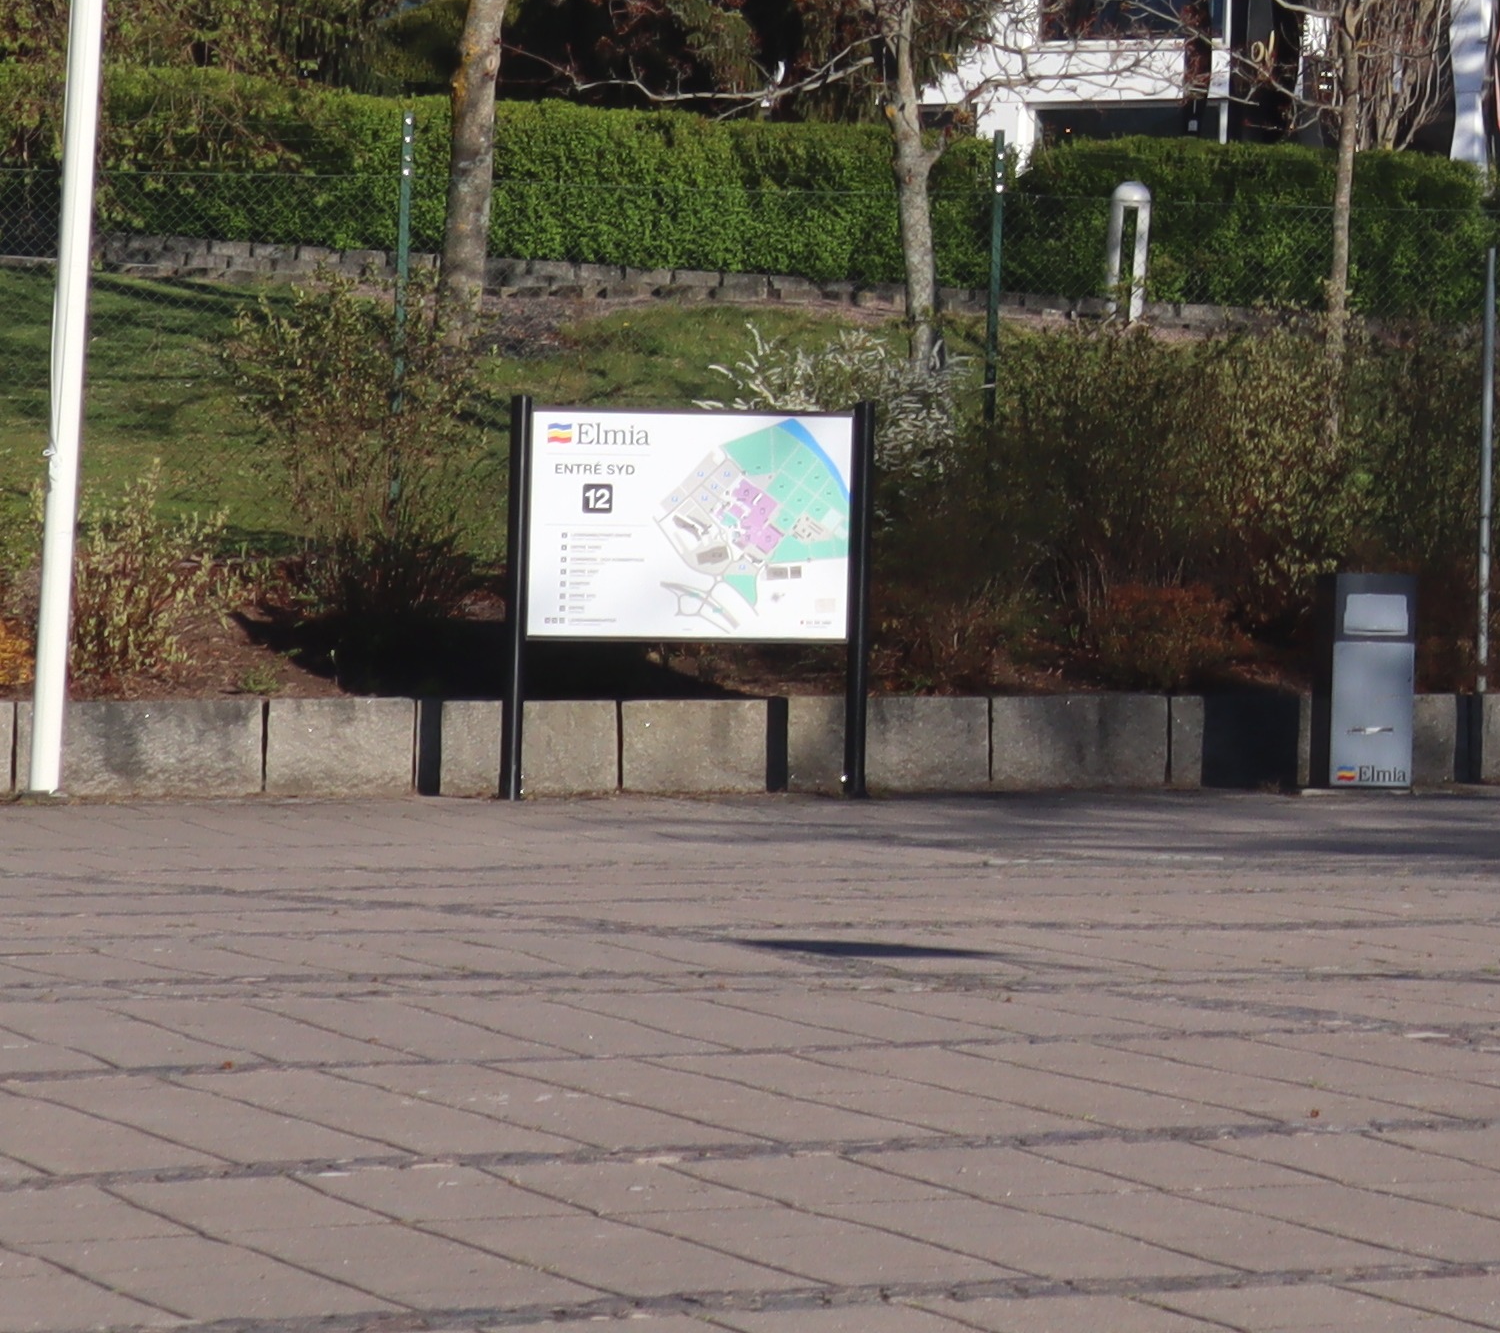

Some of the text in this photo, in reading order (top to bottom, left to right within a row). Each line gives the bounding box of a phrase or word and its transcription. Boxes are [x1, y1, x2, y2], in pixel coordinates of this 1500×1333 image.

[577, 422, 650, 445] Elmia
[555, 462, 636, 476] ENTRÉ SYD
[584, 488, 611, 509] 12
[1358, 765, 1406, 783] Elmia
